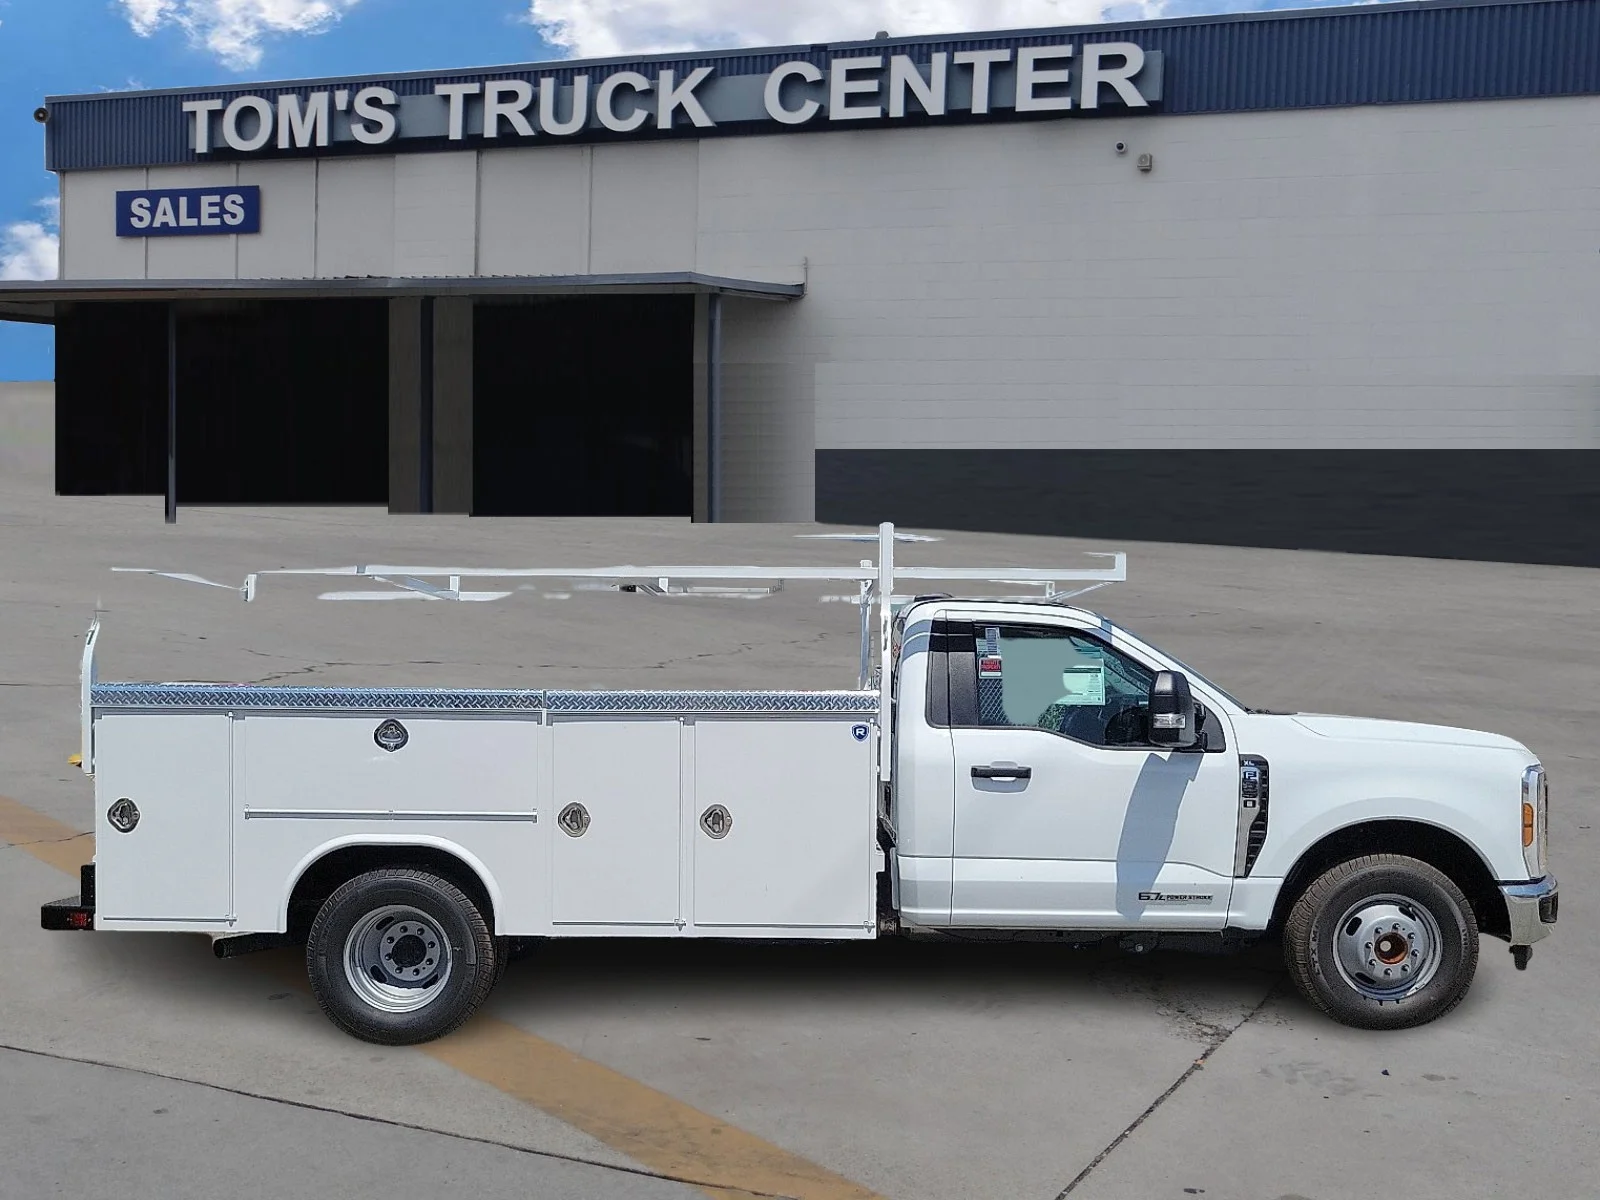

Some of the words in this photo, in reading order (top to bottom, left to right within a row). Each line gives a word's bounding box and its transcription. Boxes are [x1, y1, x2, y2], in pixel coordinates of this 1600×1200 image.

[182, 87, 398, 154] TOM'S
[434, 67, 715, 140] TRUCK
[764, 41, 1149, 124] CENTER
[129, 193, 245, 229] SALES
[856, 728, 865, 736] R
